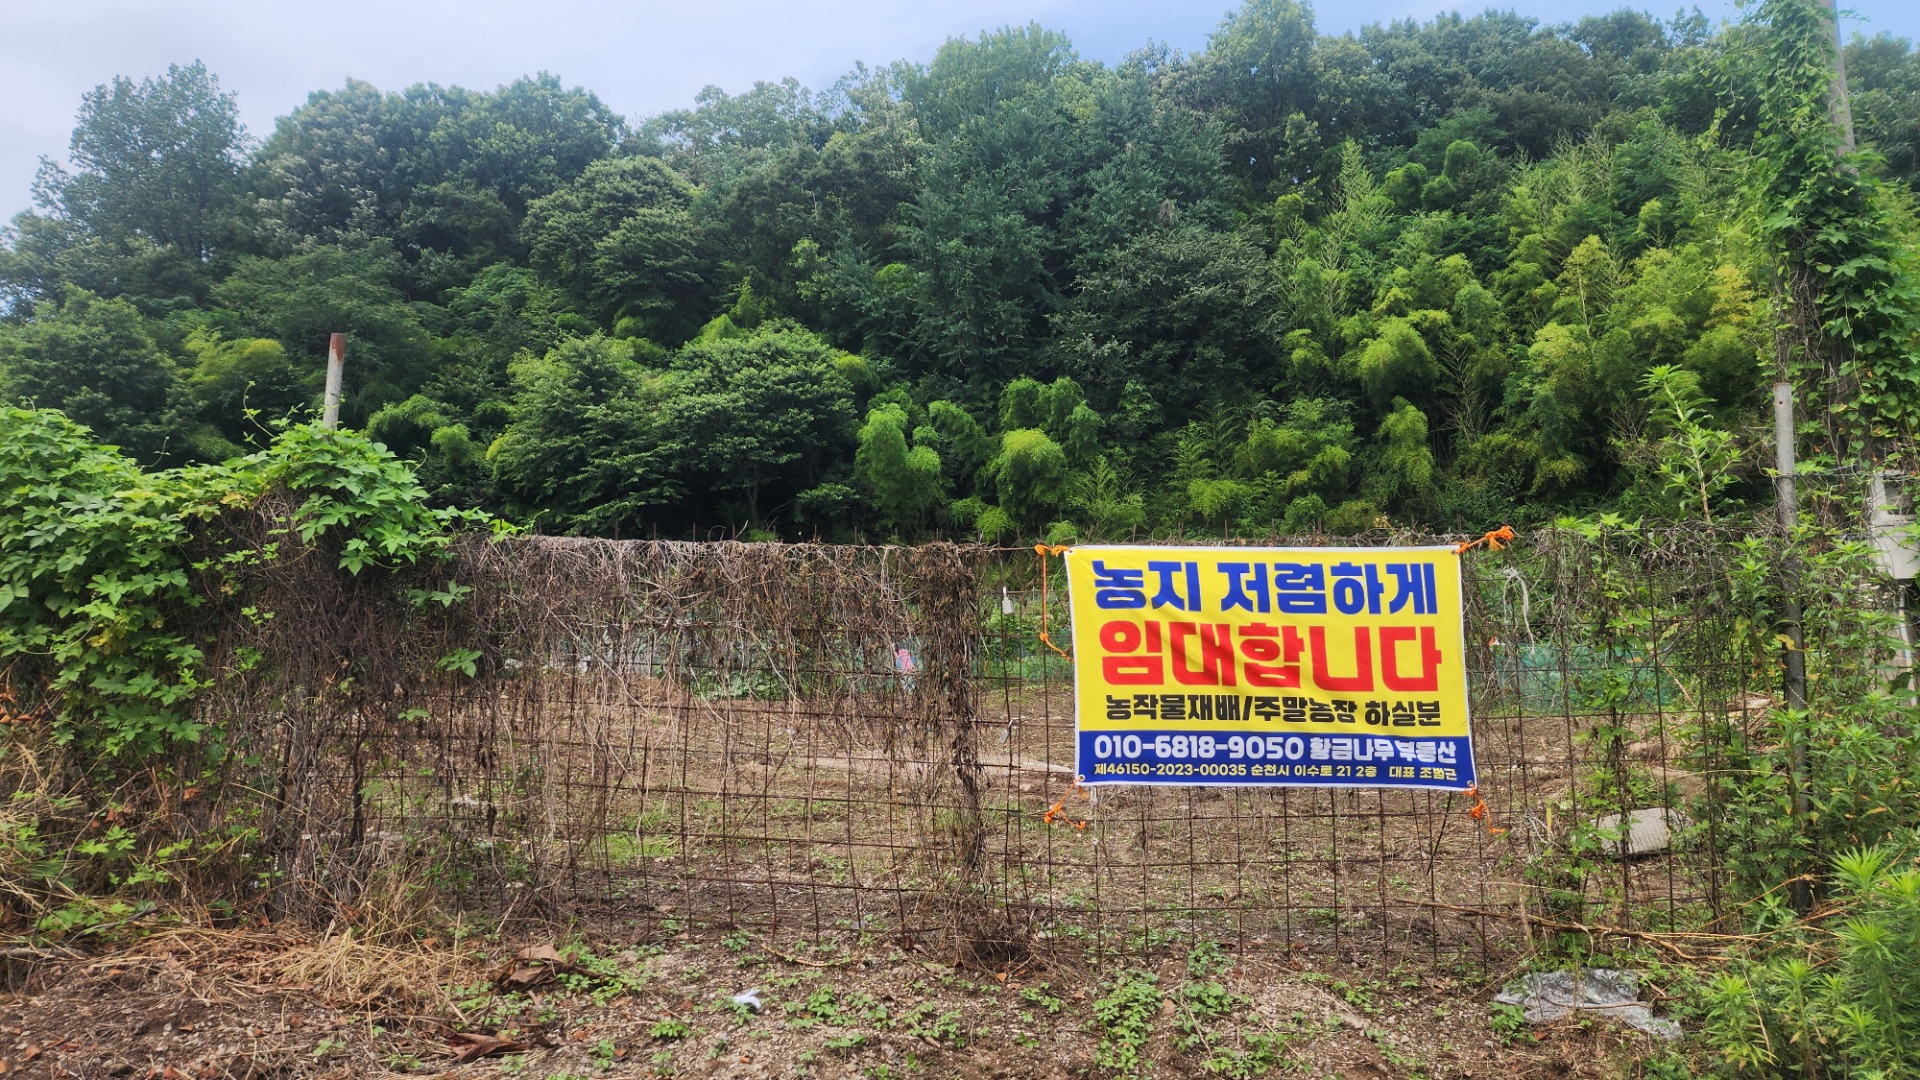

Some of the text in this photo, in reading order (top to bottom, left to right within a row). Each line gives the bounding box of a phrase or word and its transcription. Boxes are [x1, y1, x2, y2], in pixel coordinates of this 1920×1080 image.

[1091, 560, 1438, 615] 농지 저렴하게
[1099, 620, 1442, 692] 임대합니다
[1105, 693, 1441, 727] 농작물재배/주말농장 하실분
[1094, 734, 1304, 760] 010-6818-9050
[1094, 763, 1247, 776] 제46150-2023-00035
[1250, 764, 1290, 777] 순천시
[1294, 764, 1333, 777] 이수로
[1336, 765, 1351, 777] 21
[1355, 765, 1377, 778] 2층
[1388, 766, 1415, 778] 대표
